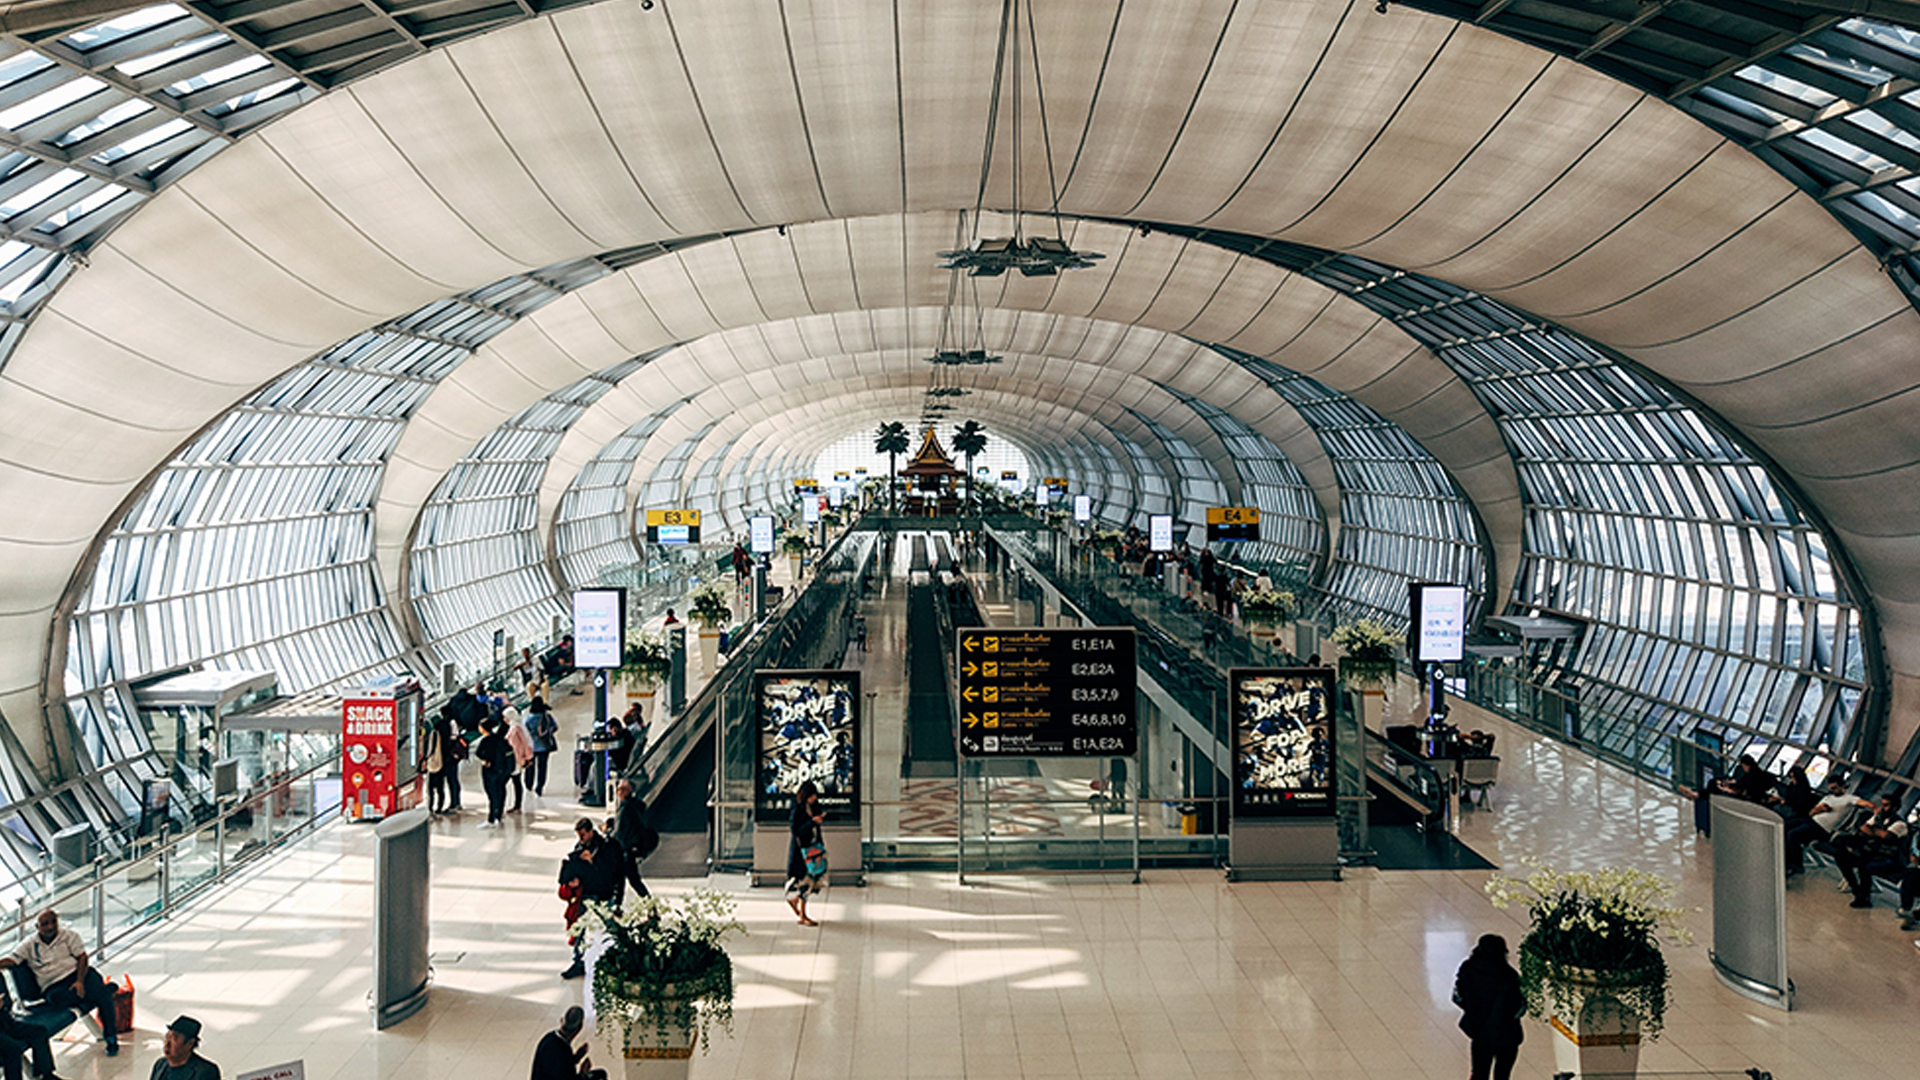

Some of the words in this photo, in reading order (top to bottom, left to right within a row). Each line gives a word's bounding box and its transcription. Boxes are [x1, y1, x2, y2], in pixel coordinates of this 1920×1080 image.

[664, 512, 681, 524] E3
[1224, 510, 1241, 521] E4
[1072, 638, 1115, 651] E1,E1A
[1072, 663, 1115, 676] E2,E2A
[1072, 689, 1119, 702] E3,5,7,9
[775, 694, 836, 724] DRIVE
[1250, 691, 1311, 720] DRIVE
[347, 706, 393, 721] SNACK
[1072, 713, 1126, 727] E4,6,8,10
[786, 732, 834, 757] FOR
[1072, 737, 1124, 750] E1A,E2A
[1262, 729, 1308, 752] FOR
[780, 761, 835, 785] MORE
[1259, 756, 1311, 780] MORE
